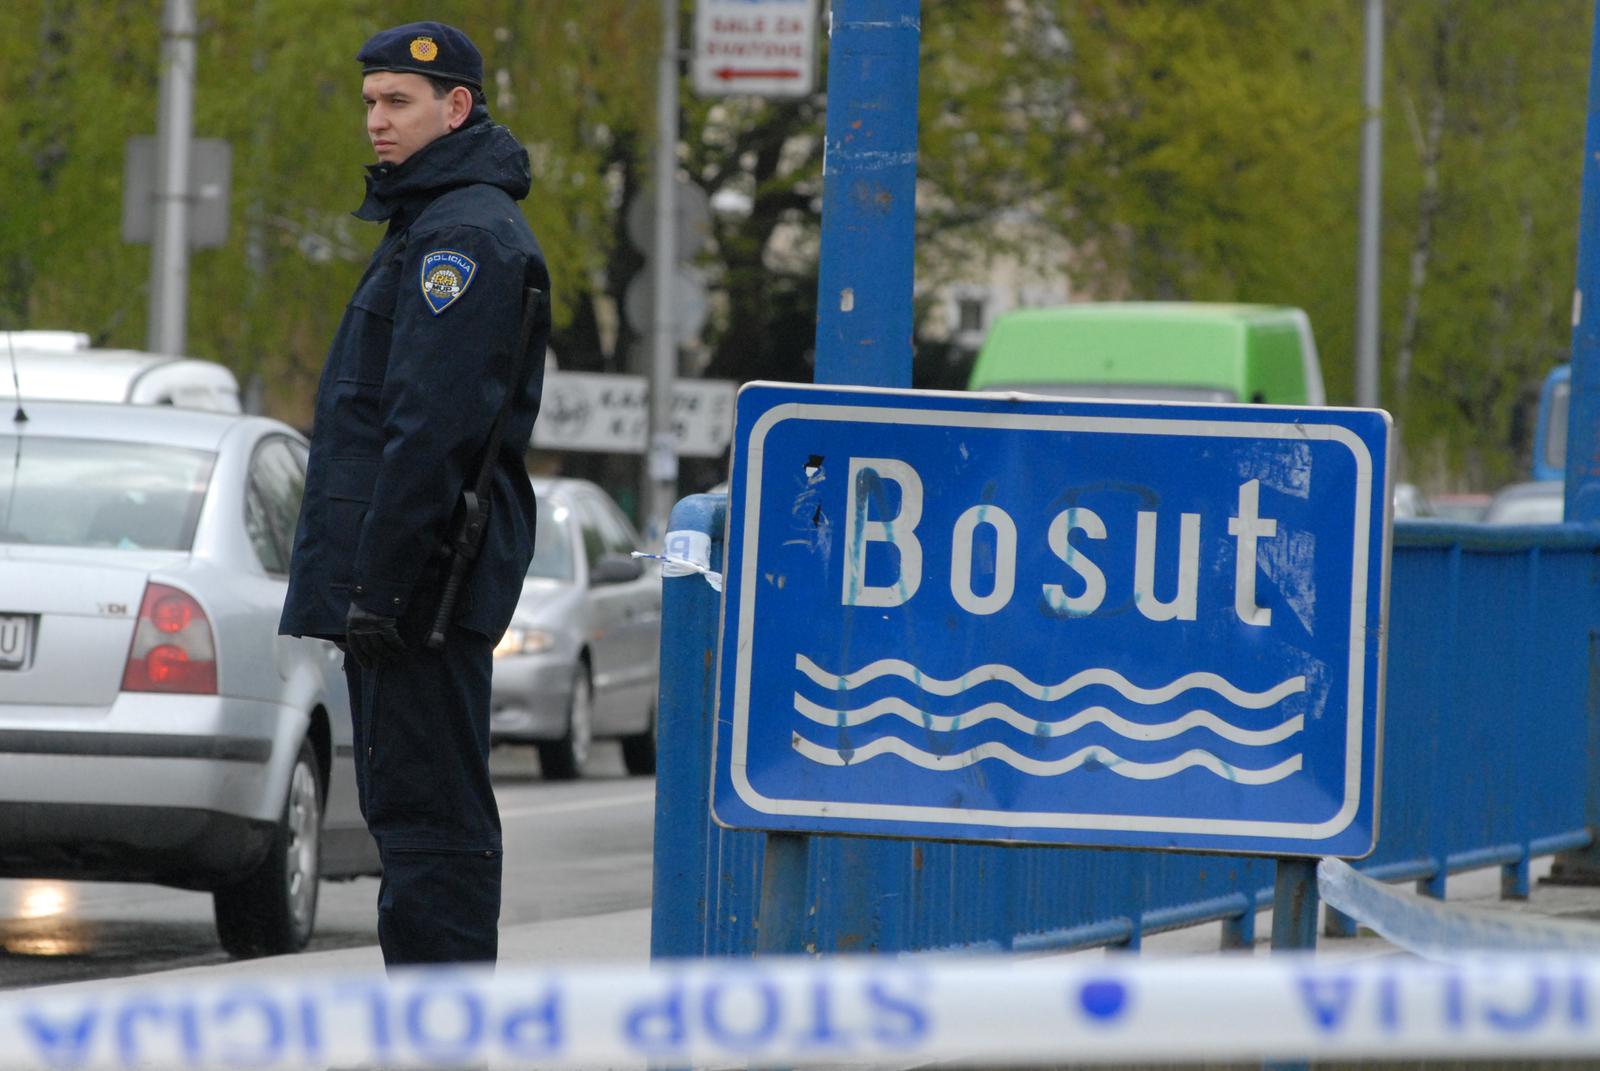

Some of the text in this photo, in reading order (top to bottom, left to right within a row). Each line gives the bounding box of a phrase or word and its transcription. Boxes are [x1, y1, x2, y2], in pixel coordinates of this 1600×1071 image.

[427, 254, 471, 273] POLICIJA
[841, 456, 1278, 627] Bosut
[20, 966, 932, 1065] STOP POLICIJA
